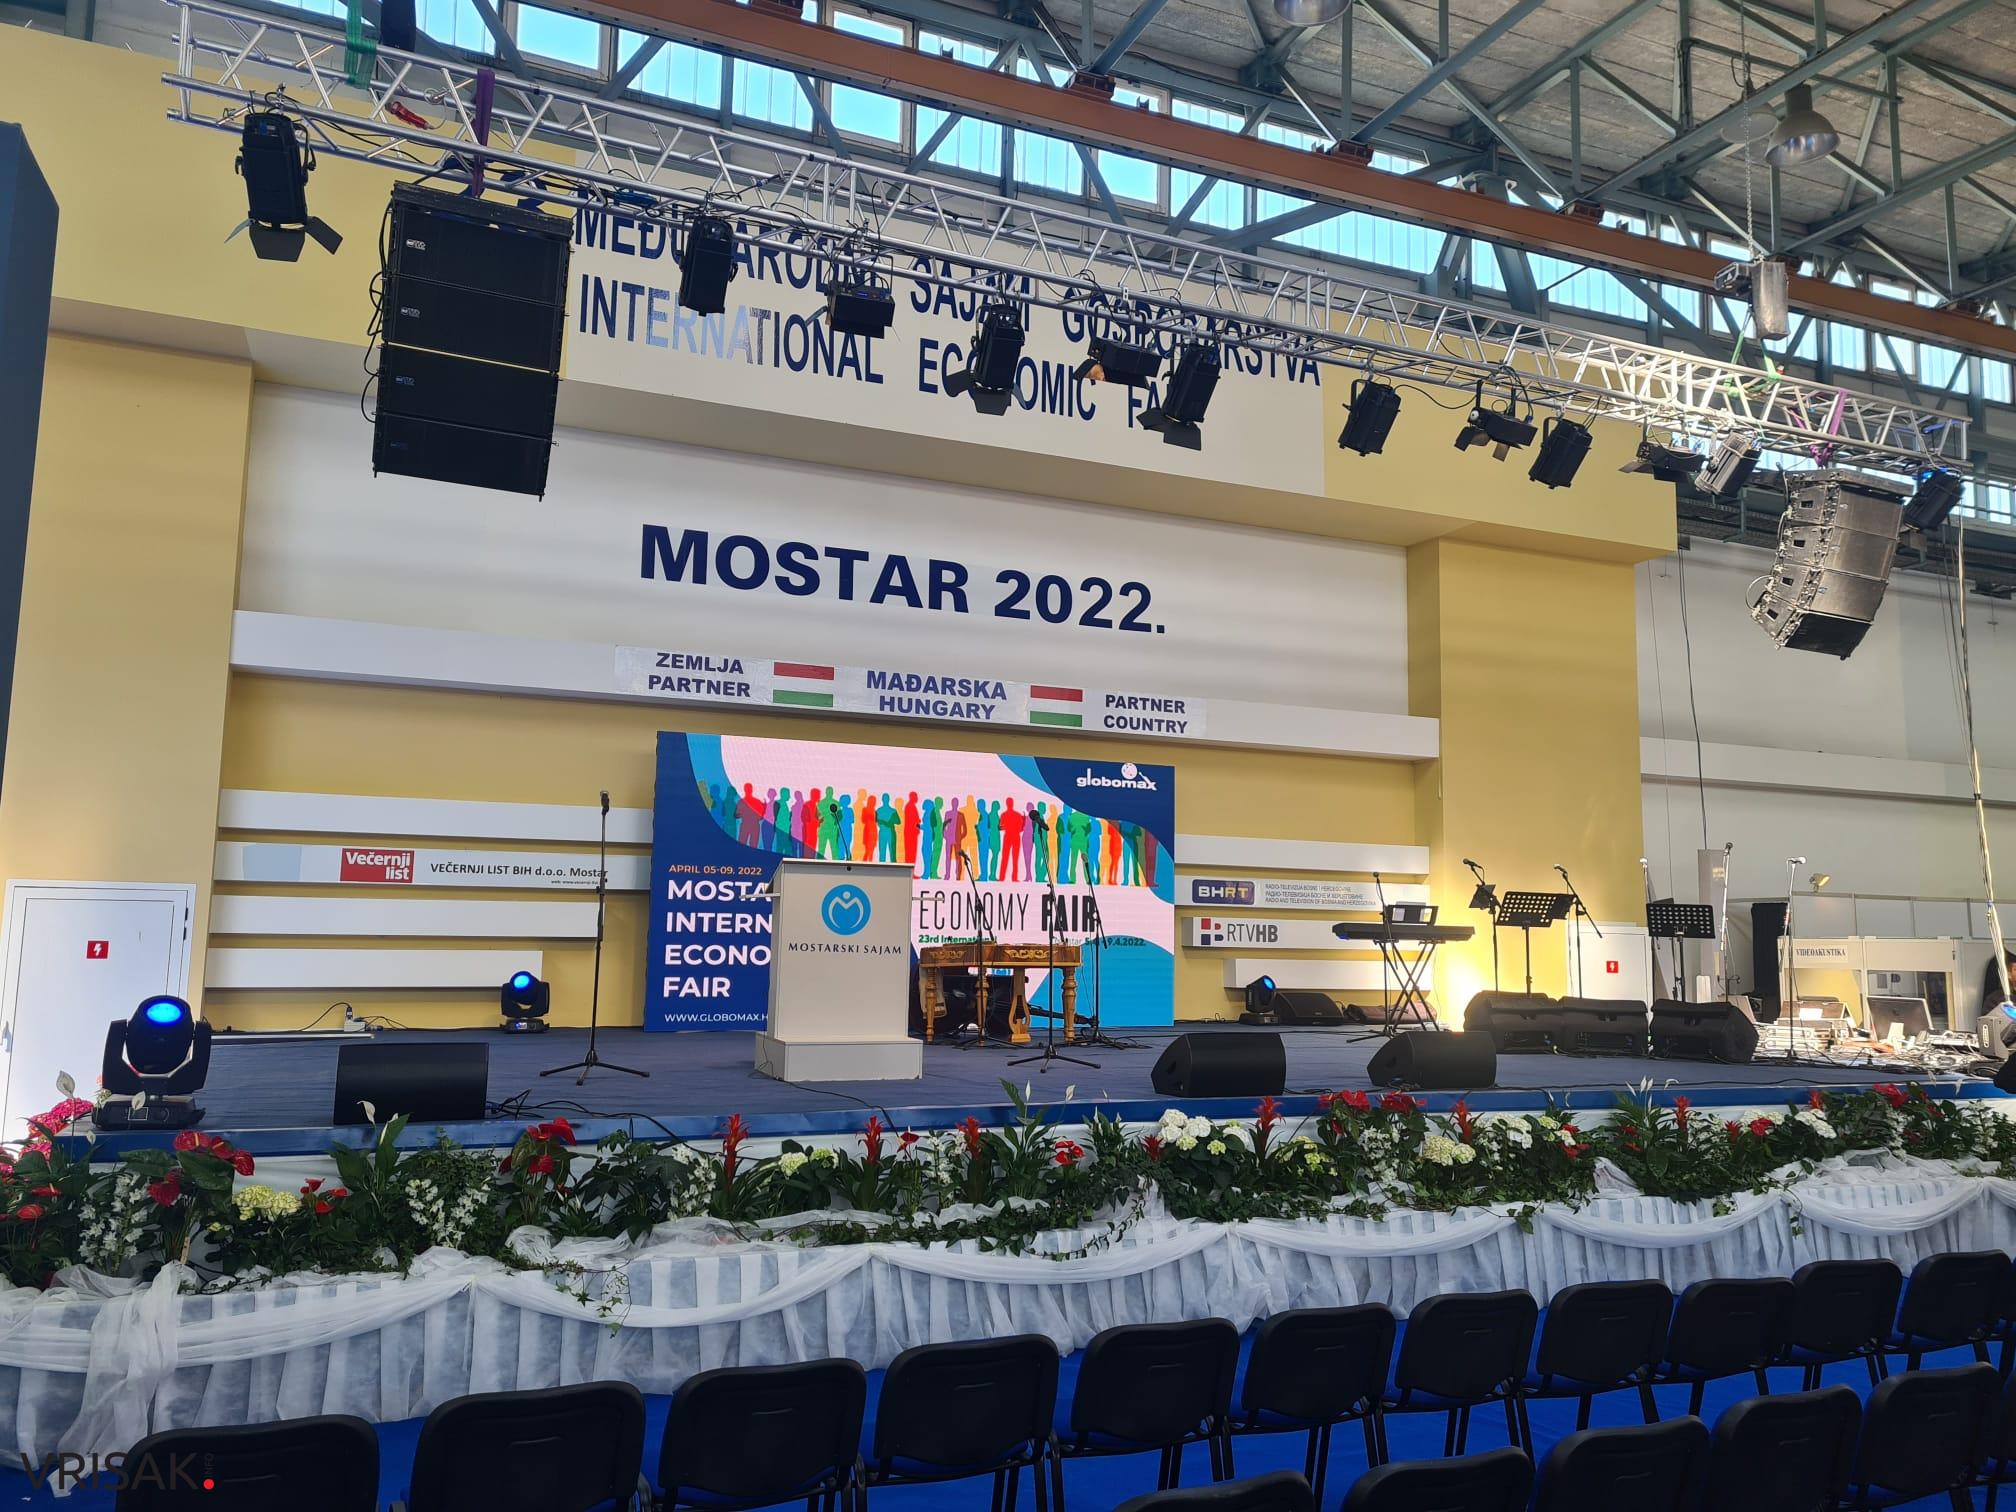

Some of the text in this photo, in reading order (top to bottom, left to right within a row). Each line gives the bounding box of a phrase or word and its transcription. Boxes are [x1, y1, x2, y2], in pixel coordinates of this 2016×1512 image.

[580, 273, 884, 384] INTERNATIONAL
[919, 337, 1096, 421] ECOMIC
[640, 523, 1166, 634] MOSTAR 2022.
[656, 652, 744, 674] ZEMLJA
[649, 675, 751, 697] PARTNER
[867, 670, 1007, 700] MAĐARSKA
[880, 696, 995, 720] HUNGARY
[1105, 694, 1186, 714] PARTNER
[1103, 715, 1188, 734] COUNTRY
[1077, 768, 1157, 791] globomax
[346, 851, 411, 868] Večernji
[431, 861, 484, 875] VEČERNJI
[487, 865, 510, 875] LIST
[513, 866, 532, 876] BIH
[535, 866, 567, 877] d.o.o.
[385, 866, 410, 880] list
[668, 864, 700, 874] APRIL
[738, 866, 763, 876] 2022
[1198, 885, 1249, 899] BHRT
[919, 890, 1097, 932] ECONOMY FAIR
[918, 934, 940, 943] 23rd
[1227, 923, 1279, 943] RTVHB
[788, 942, 902, 956] MOSTARSKI SAJAM
[663, 976, 731, 998] FAIR
